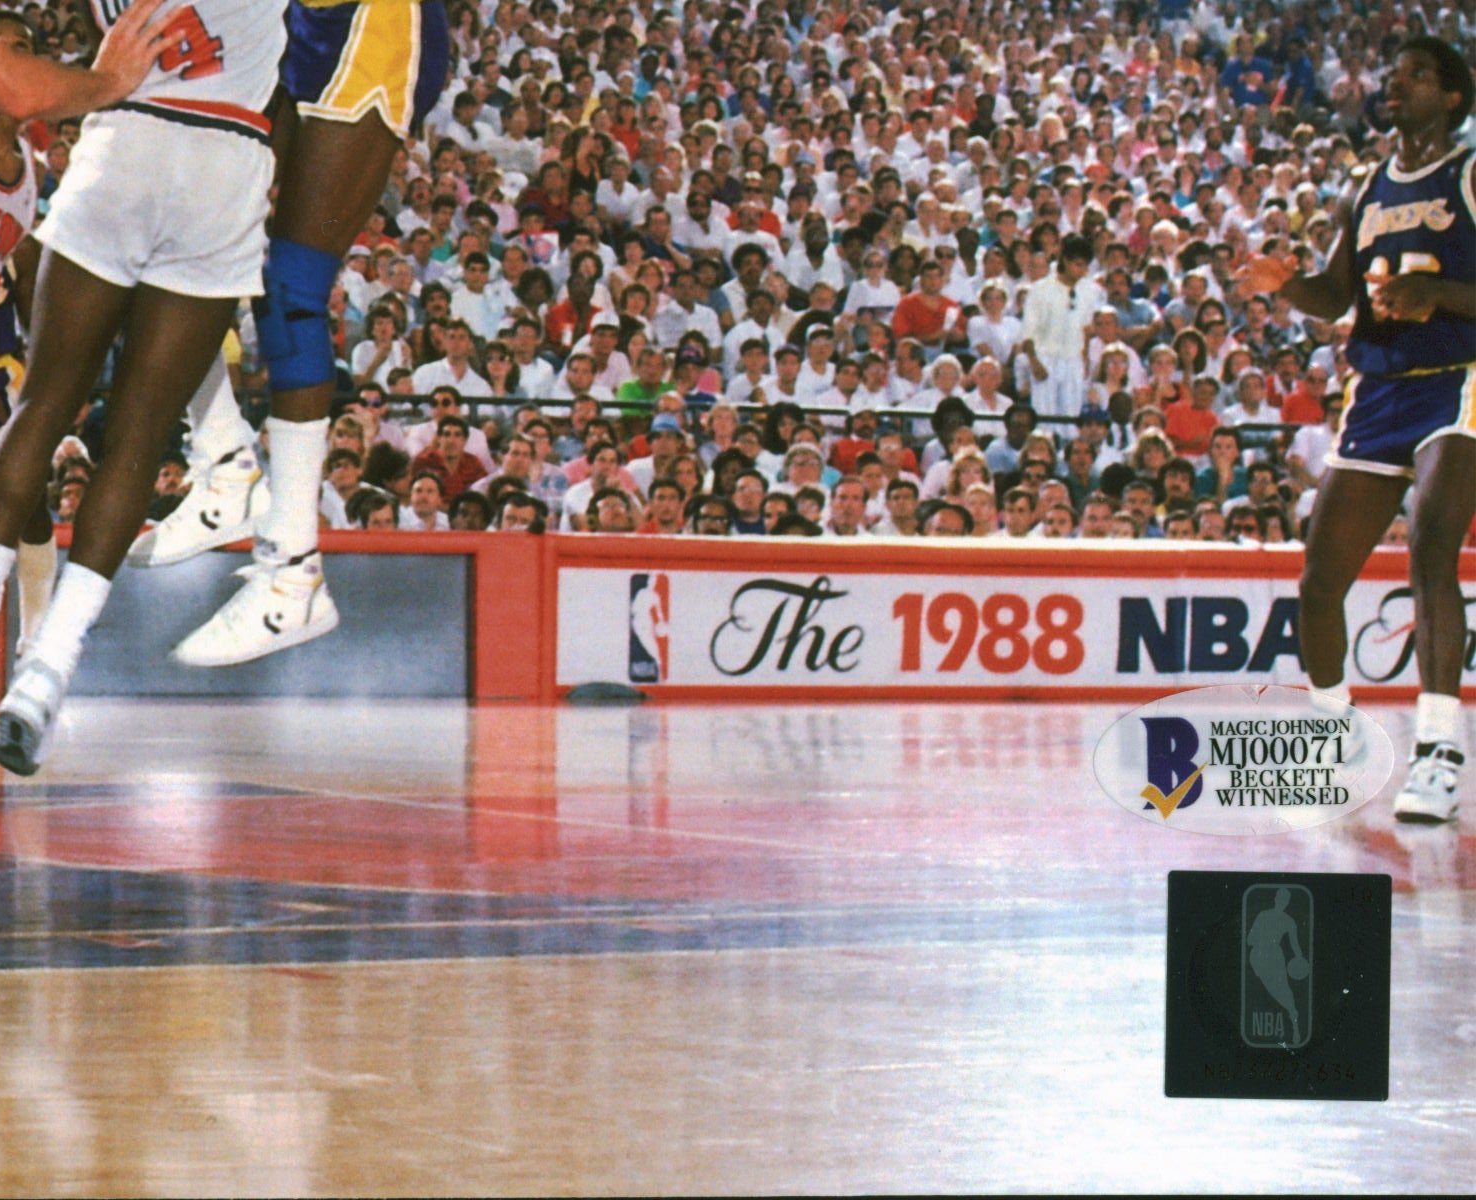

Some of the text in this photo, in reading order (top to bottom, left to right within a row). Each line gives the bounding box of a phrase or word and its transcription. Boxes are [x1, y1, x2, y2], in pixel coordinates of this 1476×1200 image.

[158, 3, 224, 81] 4
[709, 575, 865, 677] The
[891, 591, 1086, 675] 1988
[1116, 596, 1309, 674] NBA
